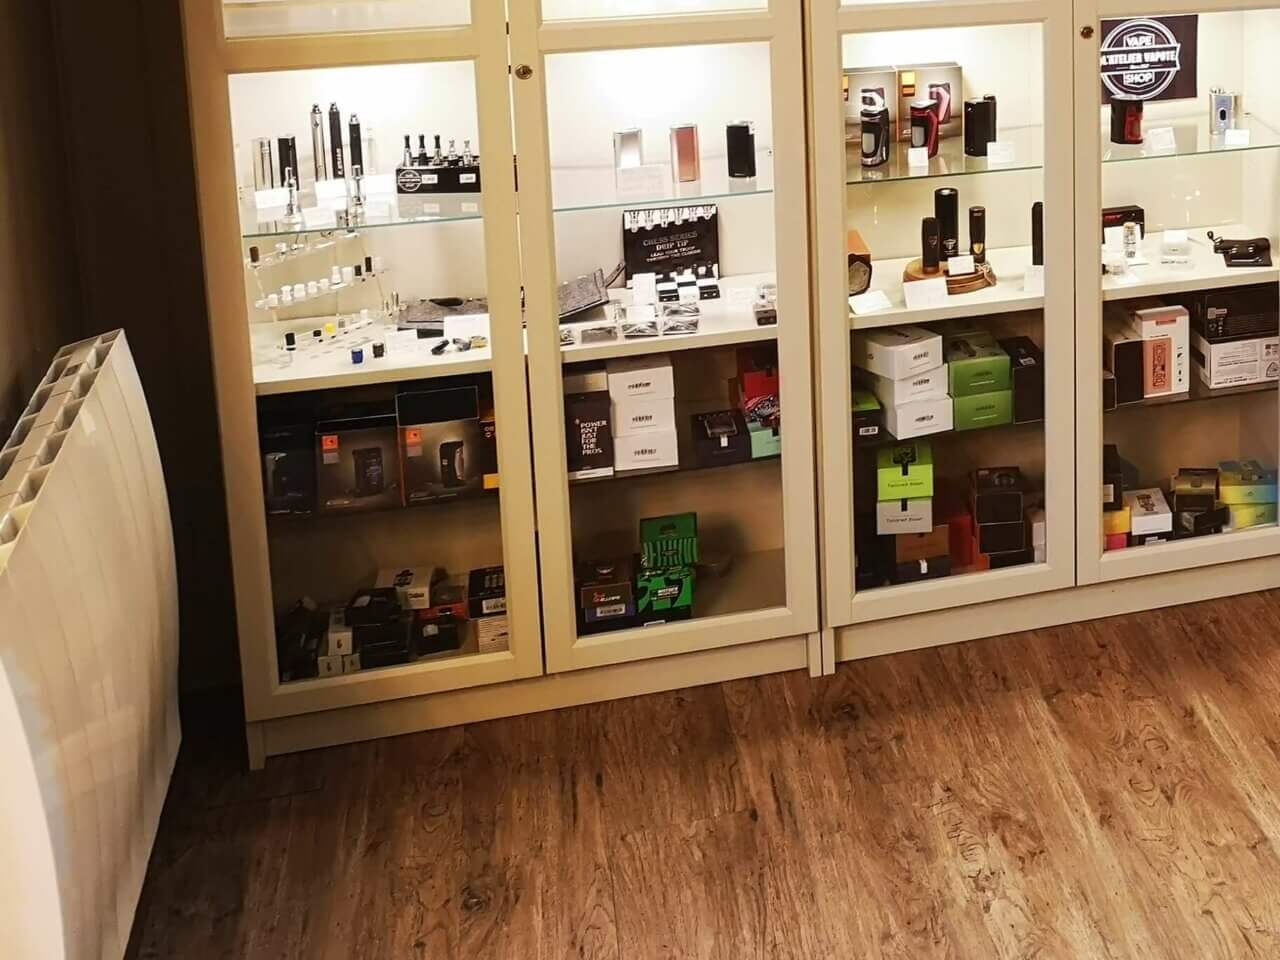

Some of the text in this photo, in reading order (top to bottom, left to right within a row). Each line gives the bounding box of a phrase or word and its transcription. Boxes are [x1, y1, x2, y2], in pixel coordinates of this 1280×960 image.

[1126, 36, 1152, 47] VAPE
[1144, 50, 1176, 62] VAPOTE
[1124, 72, 1153, 83] SHOP
[580, 419, 608, 428] POWER
